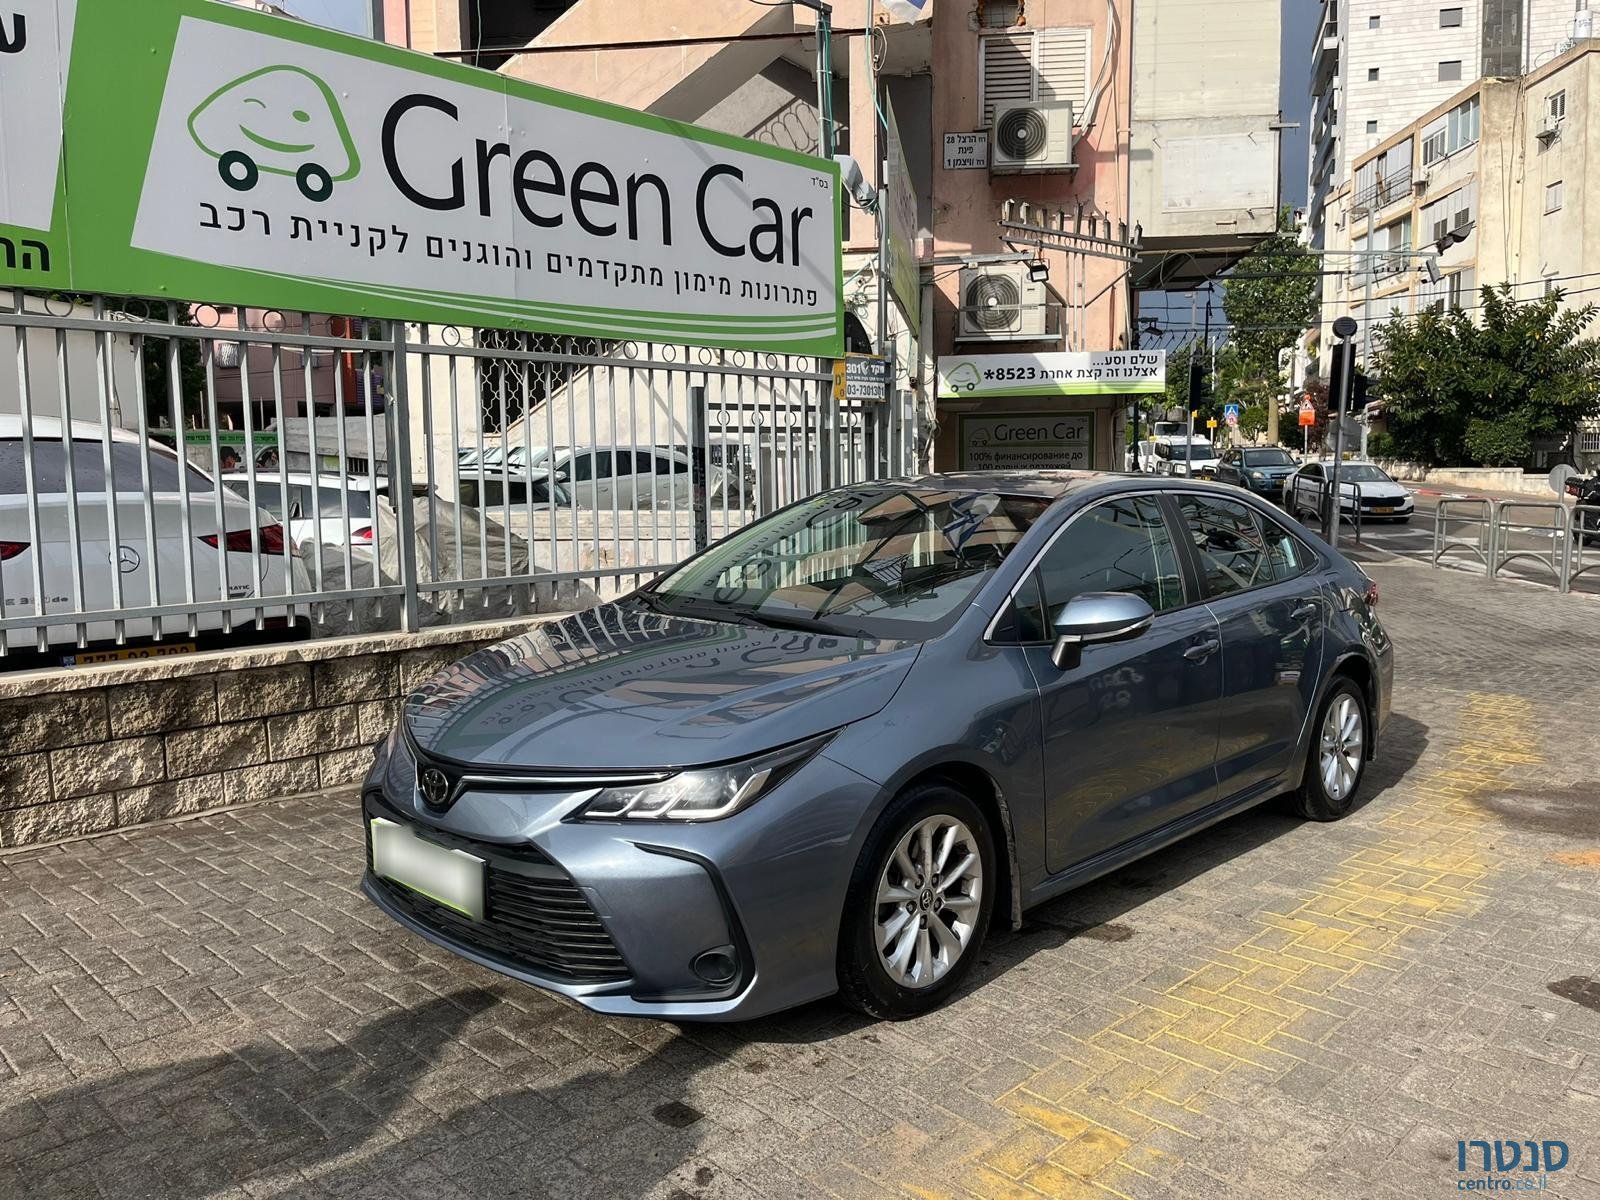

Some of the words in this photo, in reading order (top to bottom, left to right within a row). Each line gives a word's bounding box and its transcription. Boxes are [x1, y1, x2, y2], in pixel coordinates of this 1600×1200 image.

[946, 136, 955, 144] 28
[957, 135, 977, 143] הרצל
[958, 146, 974, 154] פינת
[382, 94, 672, 246] Green
[696, 164, 813, 267] Car
[811, 177, 828, 189] בס"ד
[200, 203, 271, 236] רכב
[291, 215, 409, 258] לקניית
[427, 235, 532, 271] והוגנים
[547, 252, 663, 290] מתקדמים
[675, 270, 731, 297] מימון
[741, 280, 817, 307] פתרונות
[1093, 356, 1126, 366] וסע...
[1130, 354, 1158, 365] שלם
[846, 363, 861, 374] 301
[1040, 369, 1073, 380] אחרת
[1077, 368, 1102, 380] קצת
[1106, 368, 1120, 378] זה
[1124, 366, 1158, 377] אצלנו
[994, 424, 1048, 441] Green
[1052, 422, 1084, 440] Car
[969, 452, 992, 461] 100%
[994, 452, 1069, 463] финансирование
[1071, 451, 1083, 460] до
